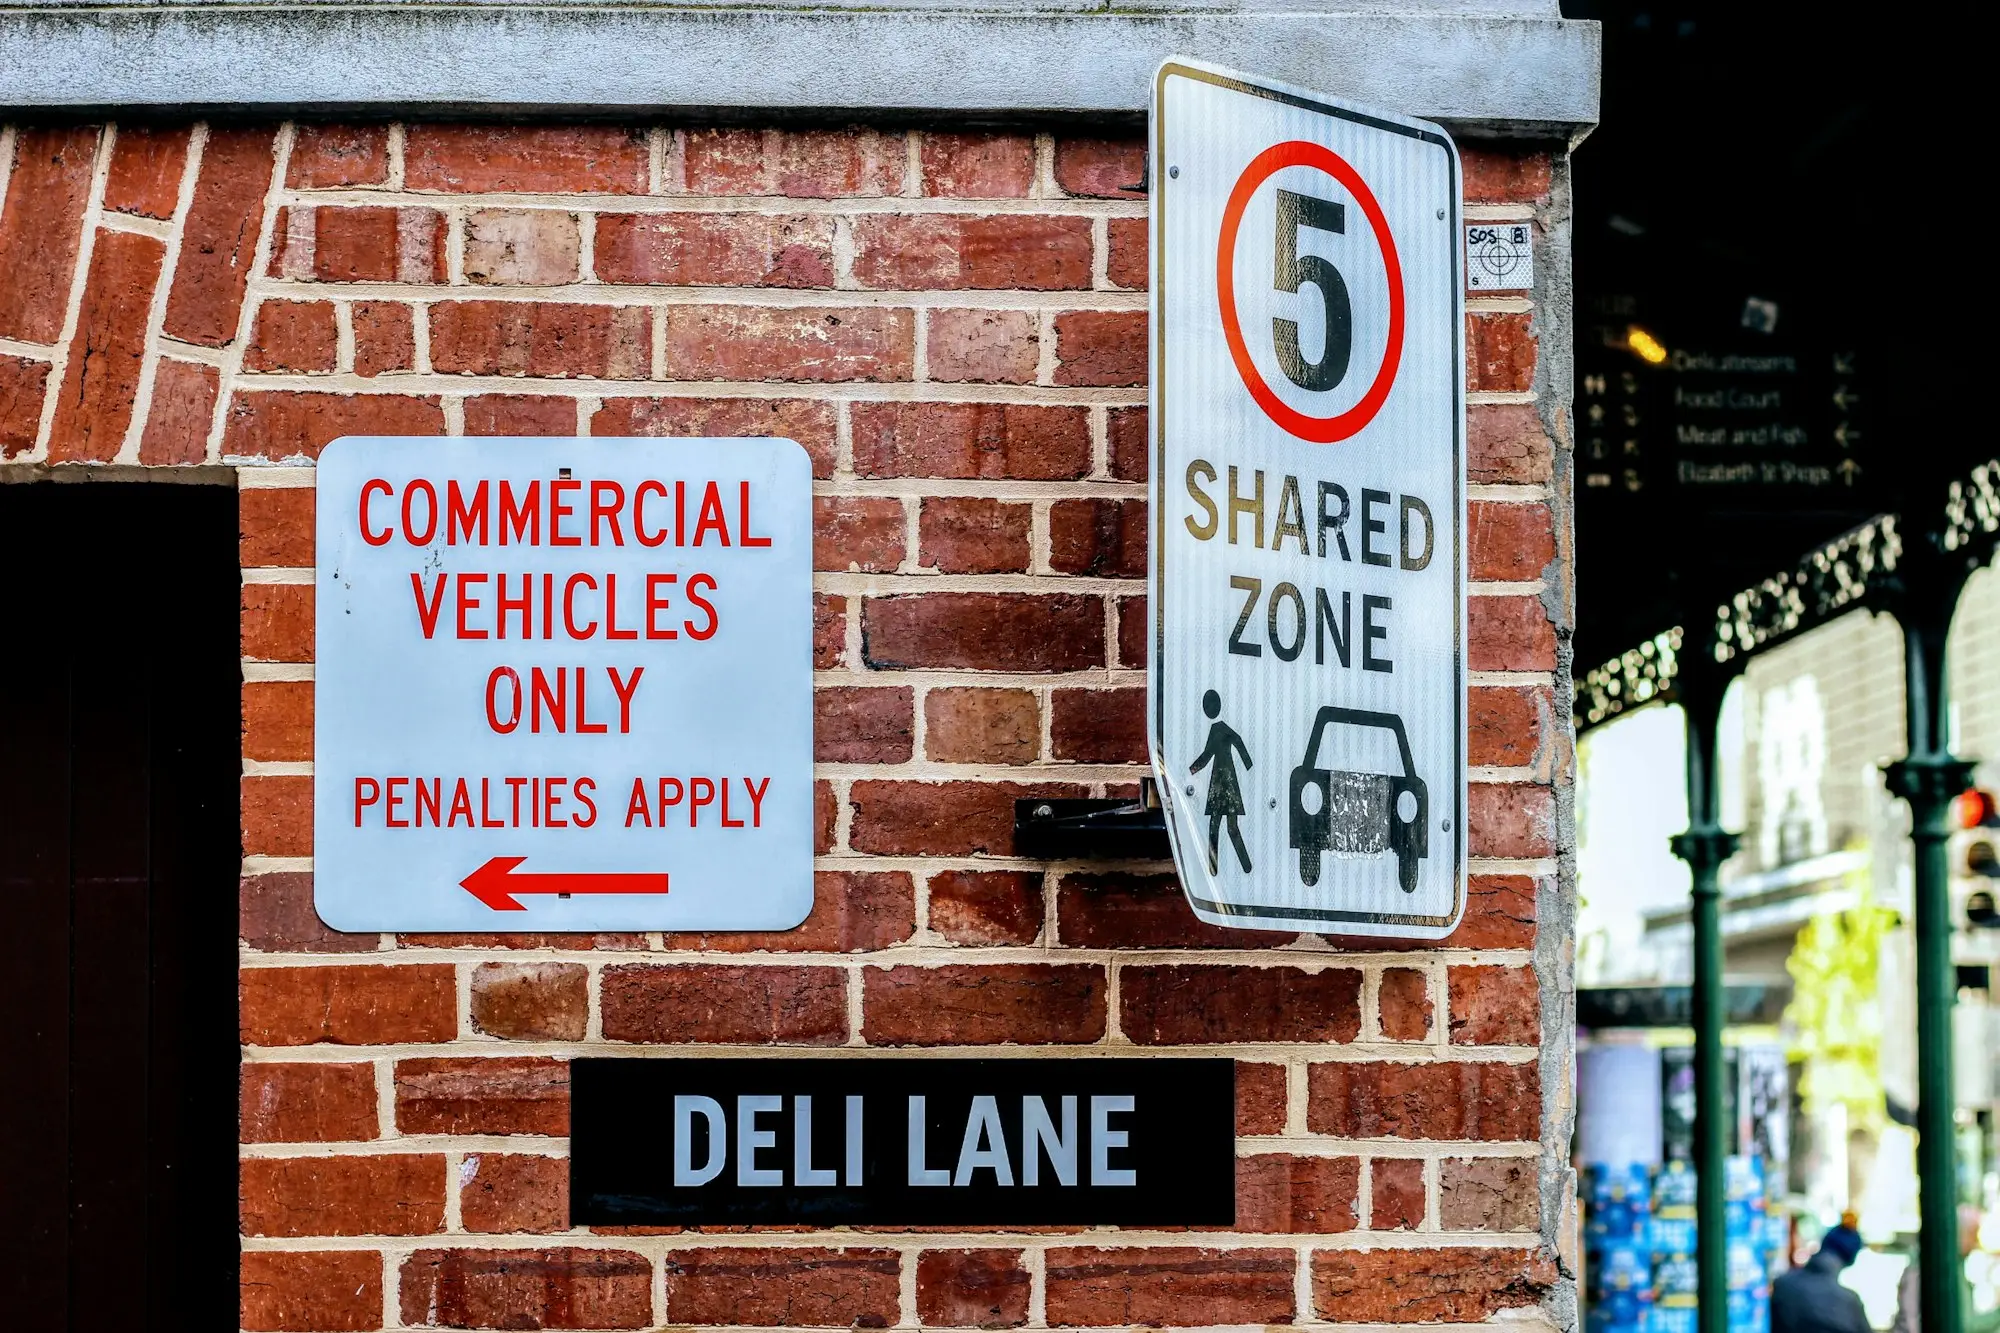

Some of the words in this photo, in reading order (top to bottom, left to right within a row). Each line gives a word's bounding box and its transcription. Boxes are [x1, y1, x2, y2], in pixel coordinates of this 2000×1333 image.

[1272, 188, 1352, 392] 5
[1675, 386, 1723, 408] Food
[1729, 387, 1781, 408] Court
[1677, 424, 1727, 445] Meat
[1732, 425, 1767, 445] and
[359, 478, 773, 548] COMMERCIAL
[1184, 459, 1434, 571] SHARED
[410, 572, 719, 641] VEHICLES
[1228, 575, 1394, 674] ZONE
[485, 666, 645, 734] ONLY
[354, 777, 598, 829] PENALTIES
[625, 777, 771, 829] APPLY
[673, 1095, 864, 1187] DELI
[907, 1095, 1137, 1187] LANE
